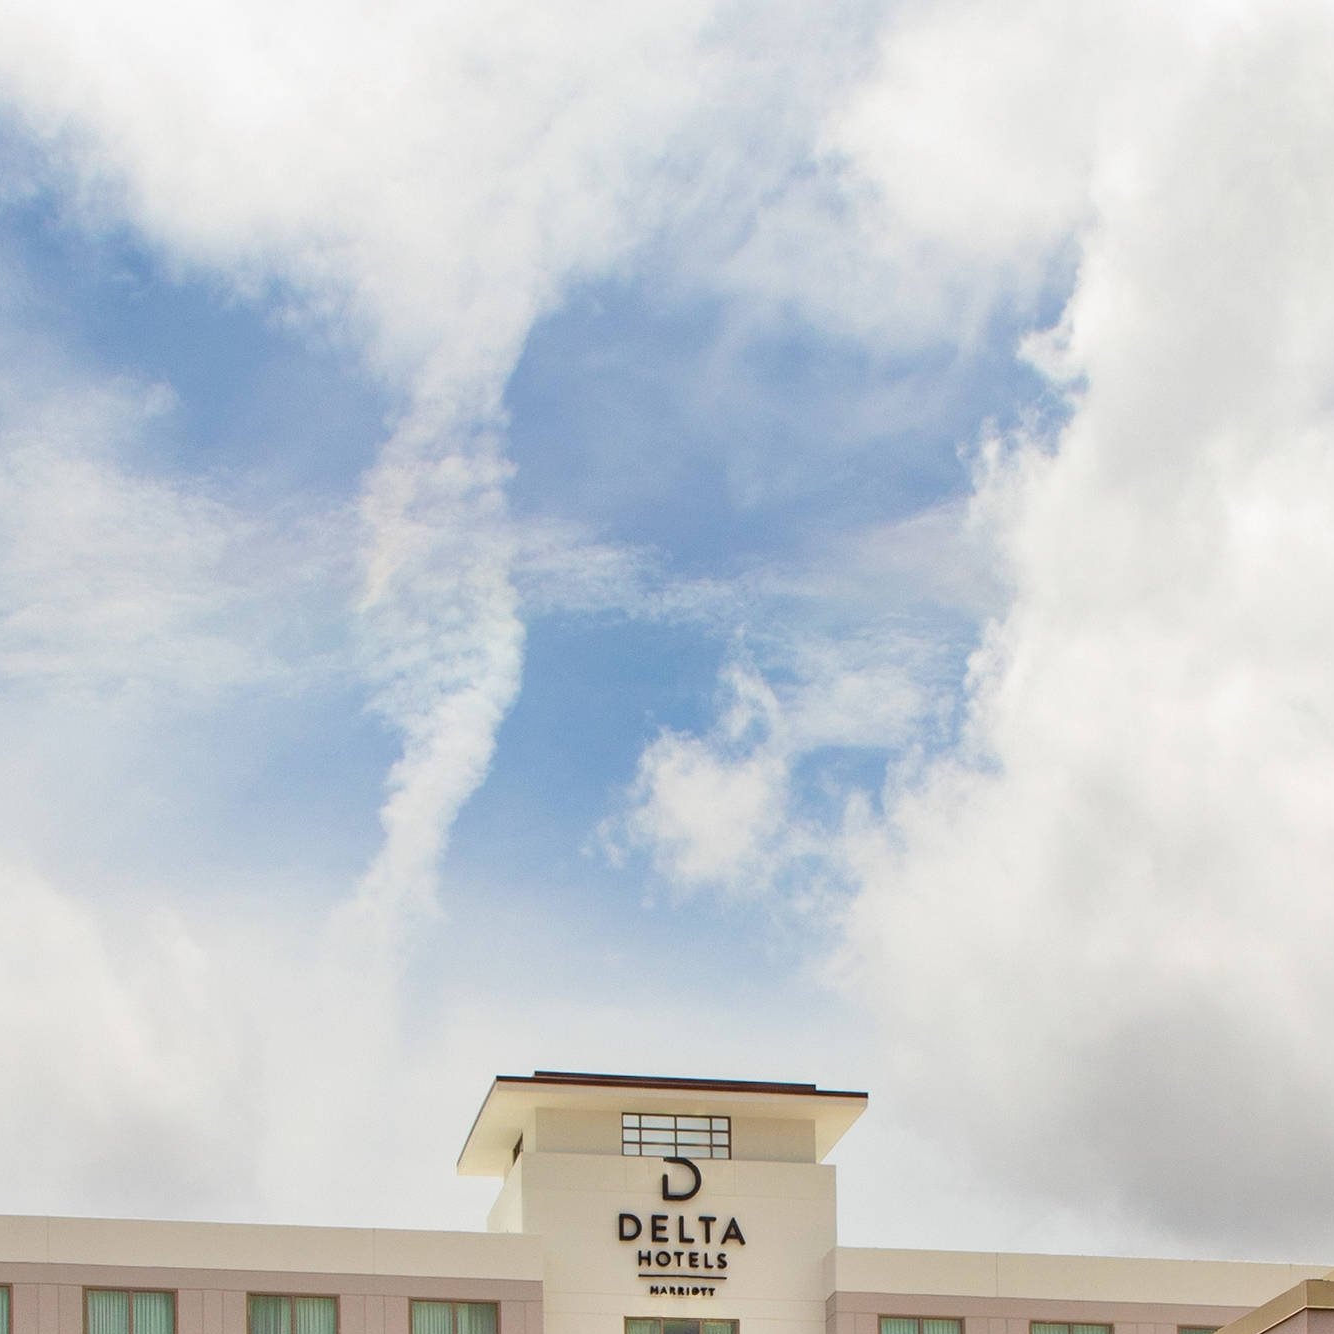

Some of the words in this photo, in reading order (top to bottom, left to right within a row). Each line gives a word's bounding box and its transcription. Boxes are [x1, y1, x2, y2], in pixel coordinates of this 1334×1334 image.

[618, 1213, 746, 1245] DELTA
[638, 1250, 728, 1269] HOTELS
[649, 1286, 716, 1297] MARRIOTT
